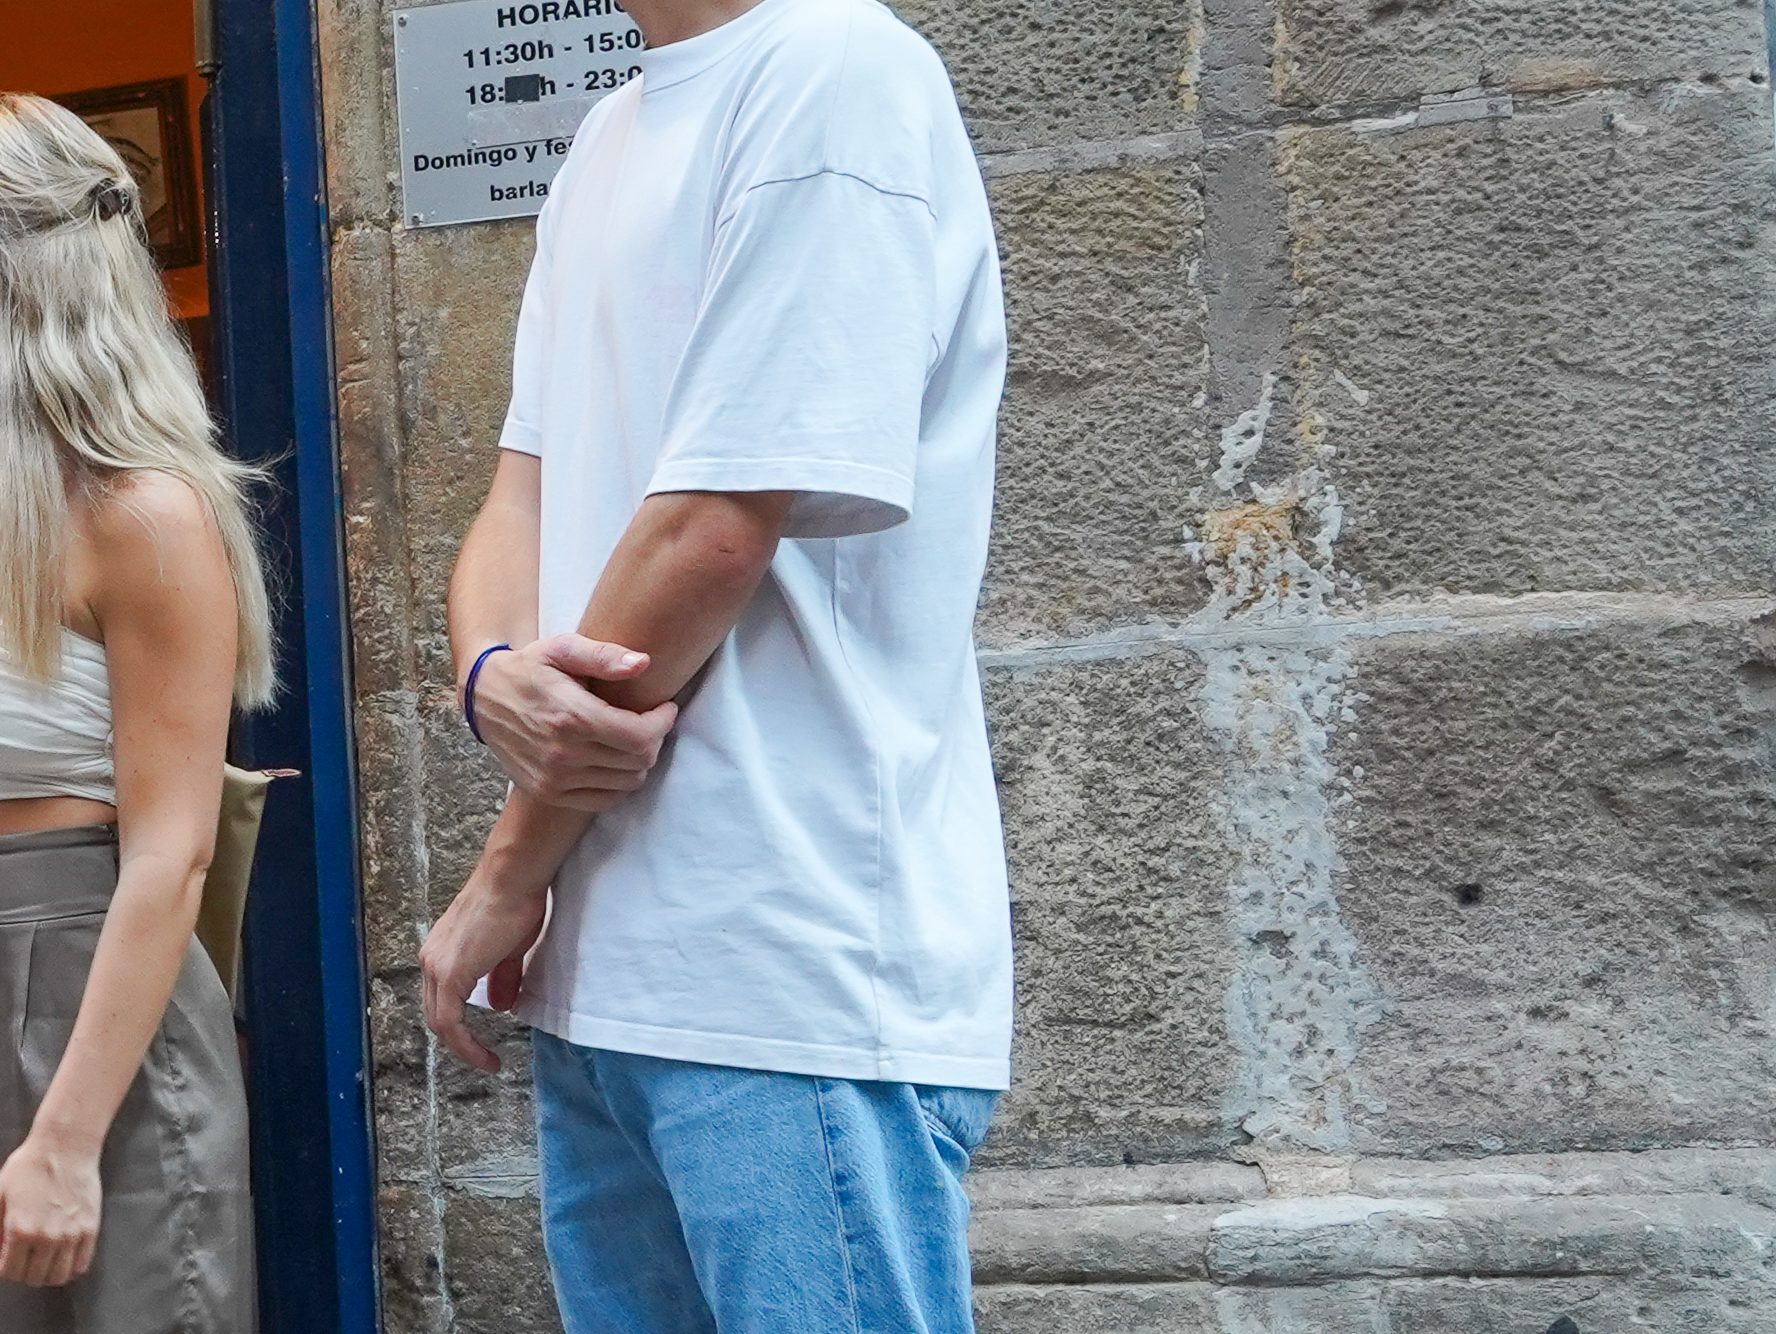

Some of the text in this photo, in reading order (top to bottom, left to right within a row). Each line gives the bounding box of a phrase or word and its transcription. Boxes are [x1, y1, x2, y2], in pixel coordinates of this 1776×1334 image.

[463, 39, 554, 69] 11:30h
[583, 28, 645, 54] 15:0
[465, 75, 557, 105] 18:h
[413, 146, 517, 172] Domingo
[525, 145, 537, 163] y
[490, 180, 552, 202] barla
